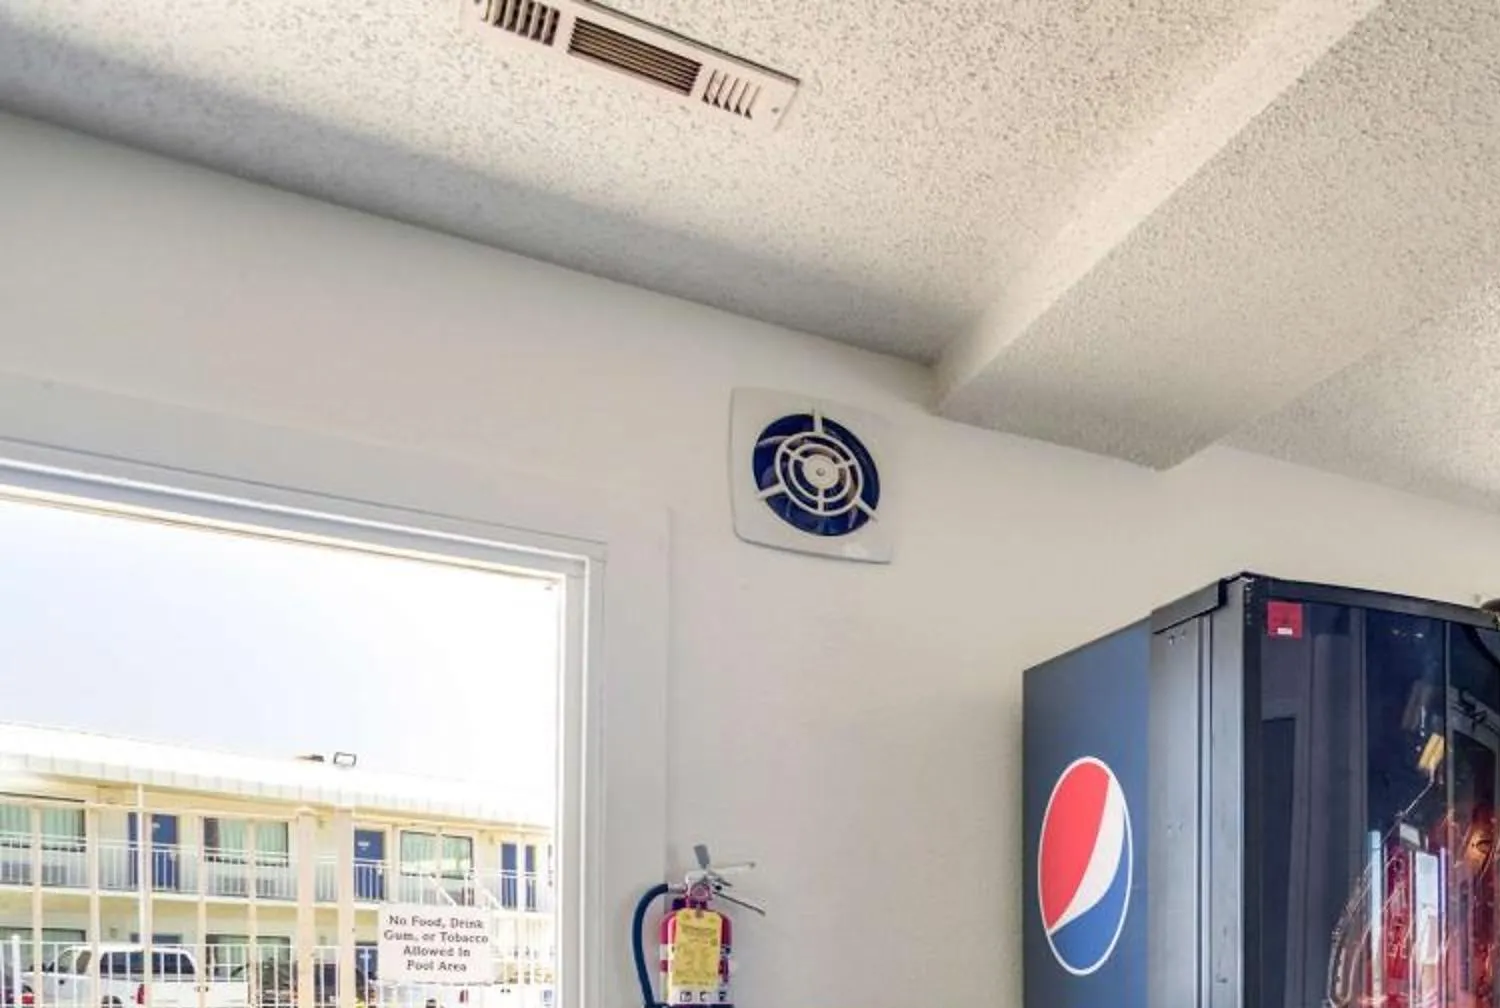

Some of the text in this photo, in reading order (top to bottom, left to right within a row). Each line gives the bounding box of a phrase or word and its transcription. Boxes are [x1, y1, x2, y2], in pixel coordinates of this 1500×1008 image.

[388, 915, 485, 929] No Food, Drink
[421, 932, 437, 942] or
[439, 931, 489, 943] Tobacco
[403, 945, 455, 957] Allowed
[406, 959, 467, 972] Pool Area
